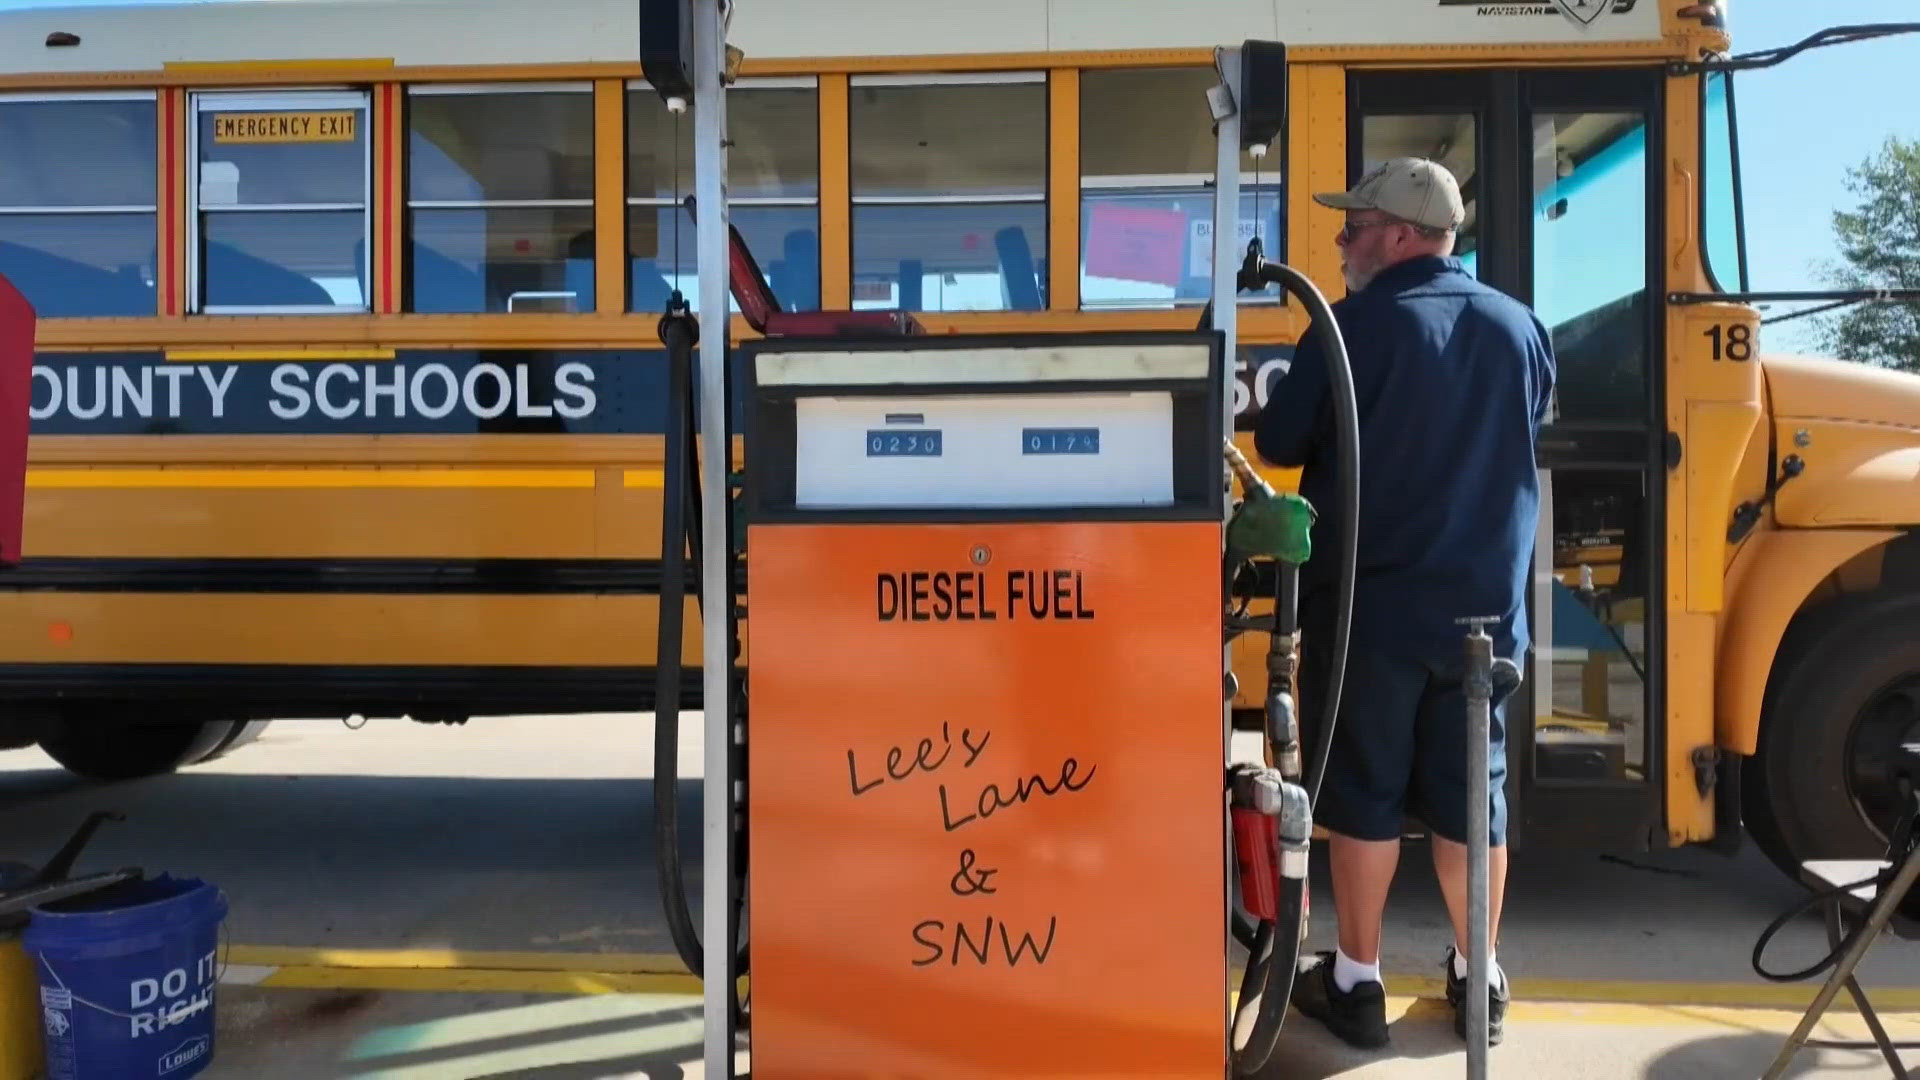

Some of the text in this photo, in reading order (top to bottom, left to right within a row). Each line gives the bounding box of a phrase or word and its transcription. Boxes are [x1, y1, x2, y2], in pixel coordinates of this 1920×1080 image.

[1477, 7, 1543, 15] NAVISTAR
[215, 116, 354, 136] EMERGENCY EXIT
[1703, 323, 1751, 362] 18
[268, 362, 597, 419] SCHOOLS
[872, 436, 934, 453] 0230
[877, 569, 1095, 622] DIESEL FUEL
[847, 721, 991, 796] Lee's
[938, 757, 1097, 832] Lane
[950, 848, 998, 896] &
[911, 916, 1057, 967] SNW
[130, 950, 216, 1010] DO IT
